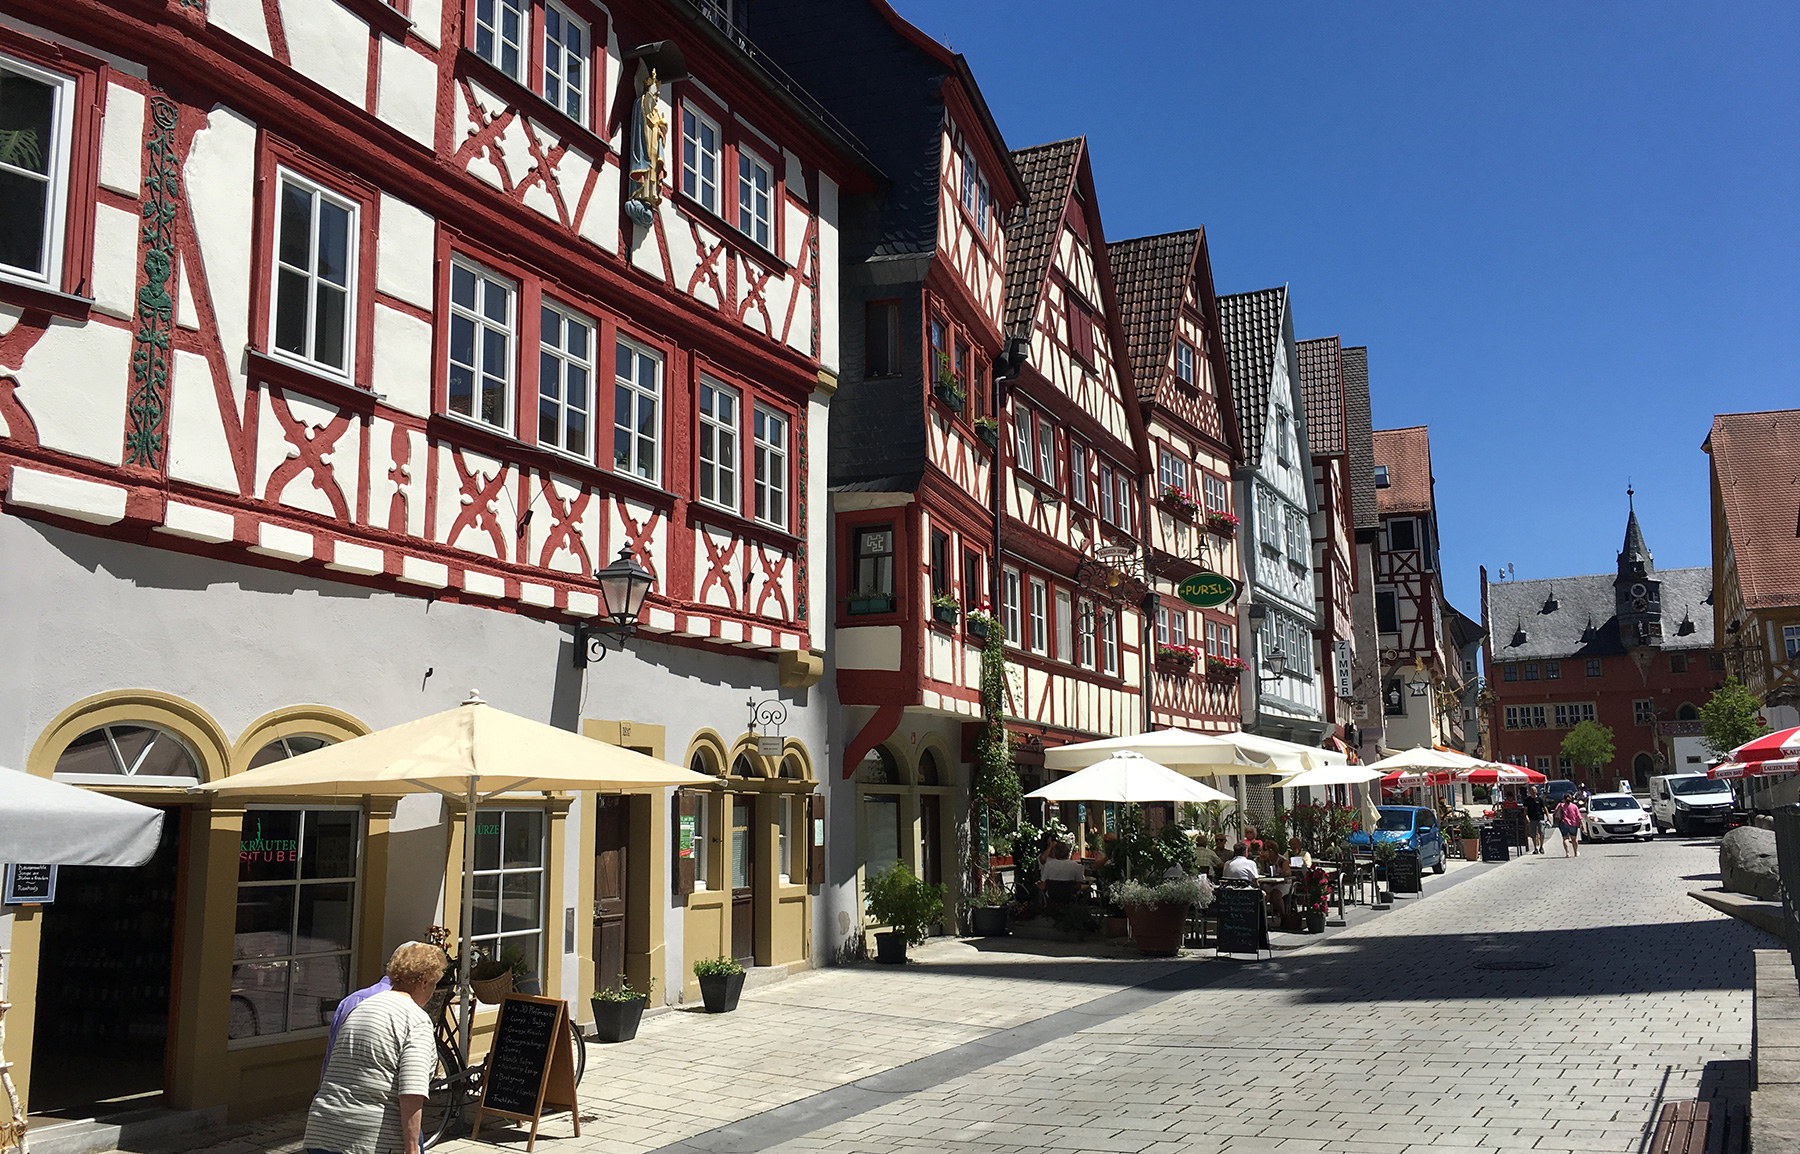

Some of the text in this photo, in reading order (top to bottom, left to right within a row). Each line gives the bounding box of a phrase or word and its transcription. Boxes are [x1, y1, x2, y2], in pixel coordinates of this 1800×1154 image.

[1338, 642, 1349, 696] ZIMMER
[240, 839, 297, 851] KRÄUTER
[240, 850, 297, 863] STUBE
